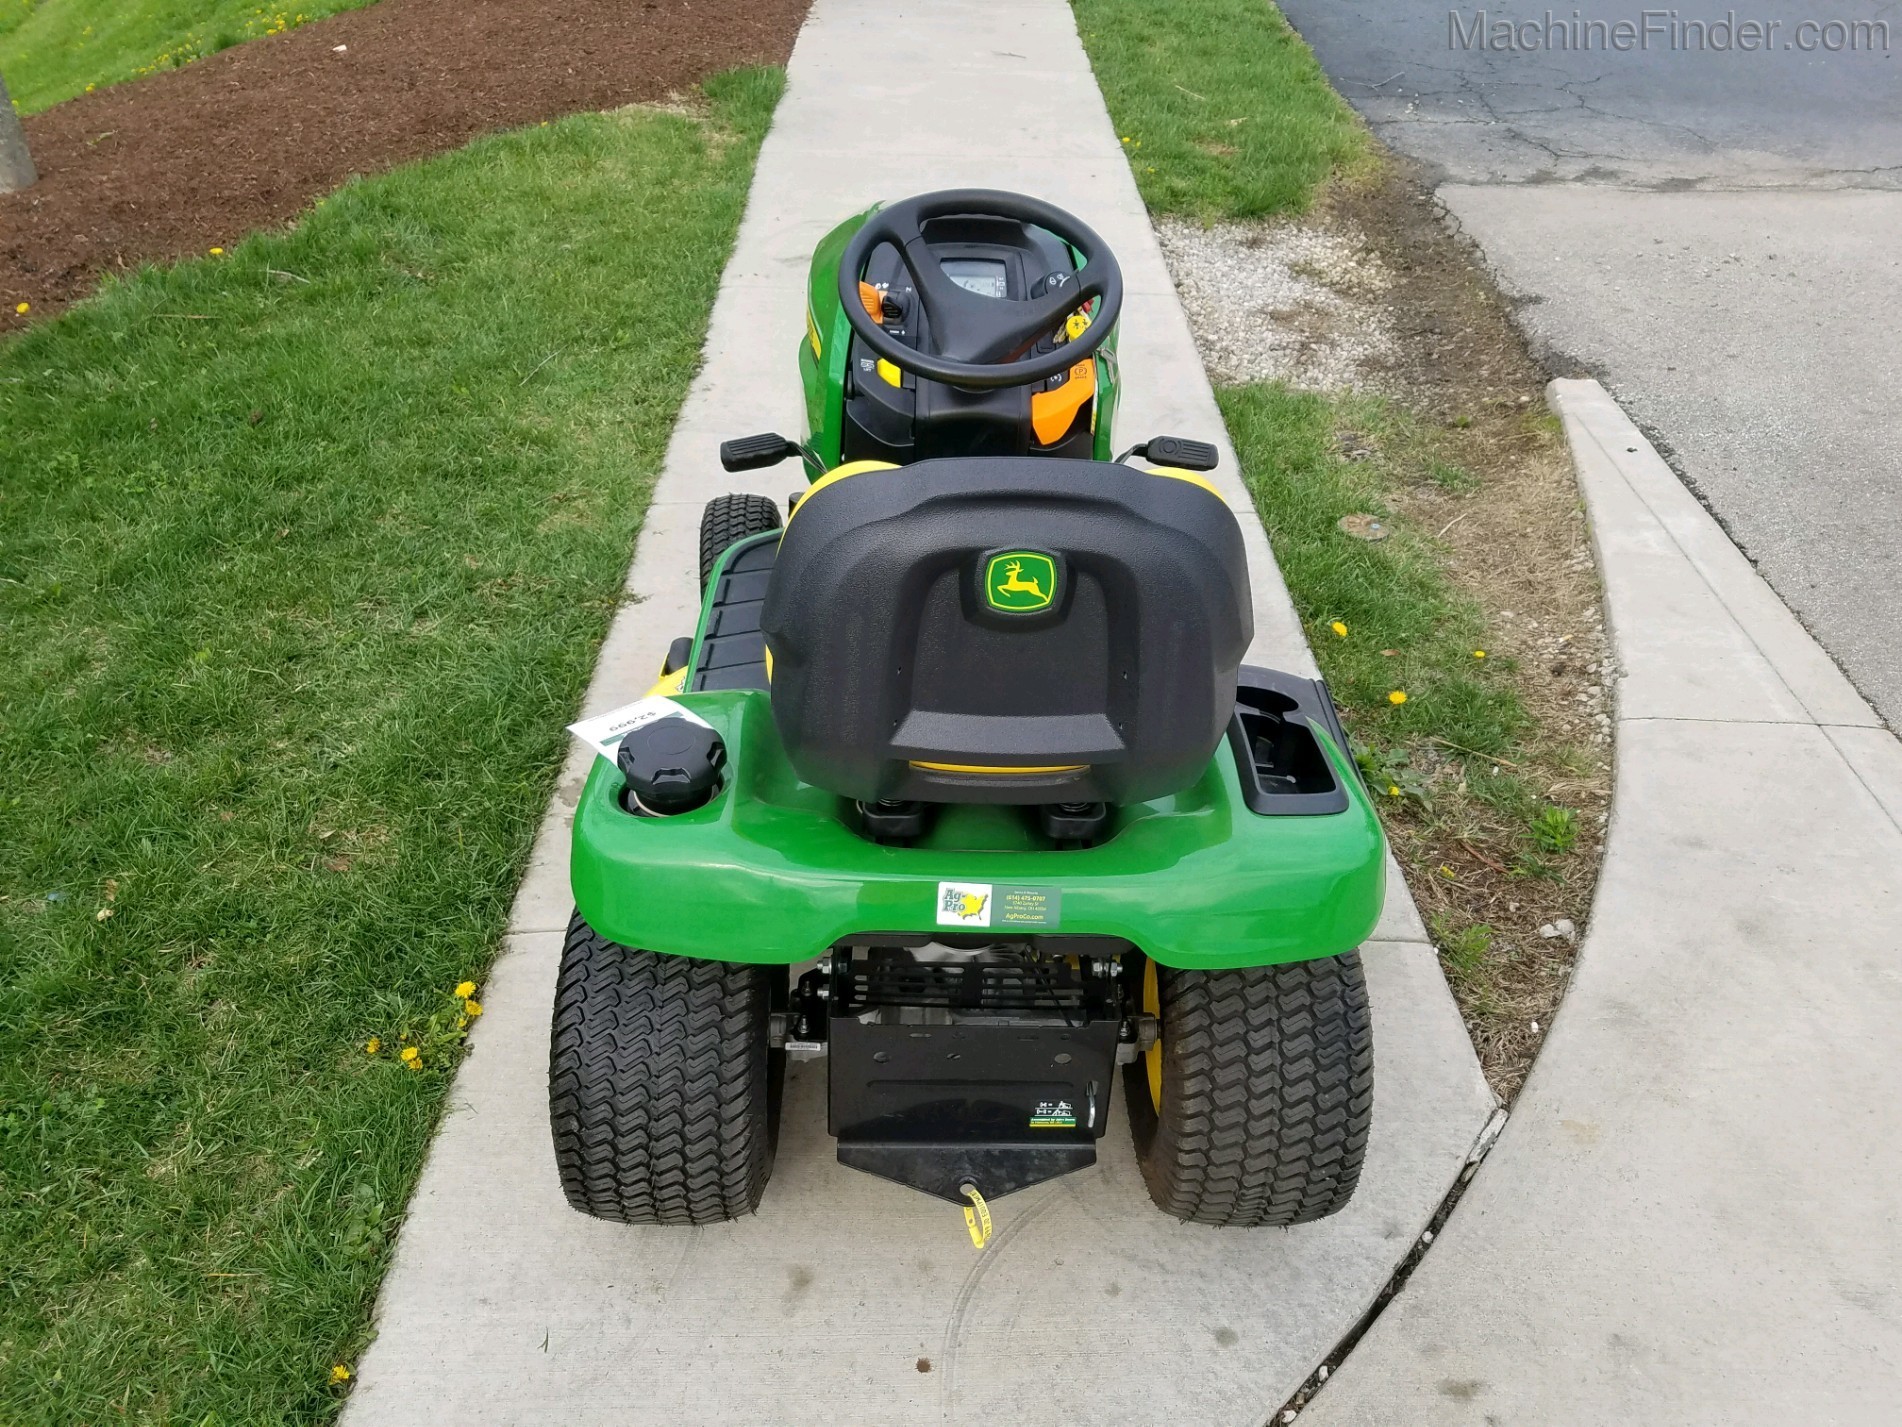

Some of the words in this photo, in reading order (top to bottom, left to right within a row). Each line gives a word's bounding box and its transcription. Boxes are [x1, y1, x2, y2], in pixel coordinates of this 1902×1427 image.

[943, 888, 966, 901] Ag-
[943, 900, 966, 911] Pro
[1005, 912, 1044, 920] AgProCo.com
